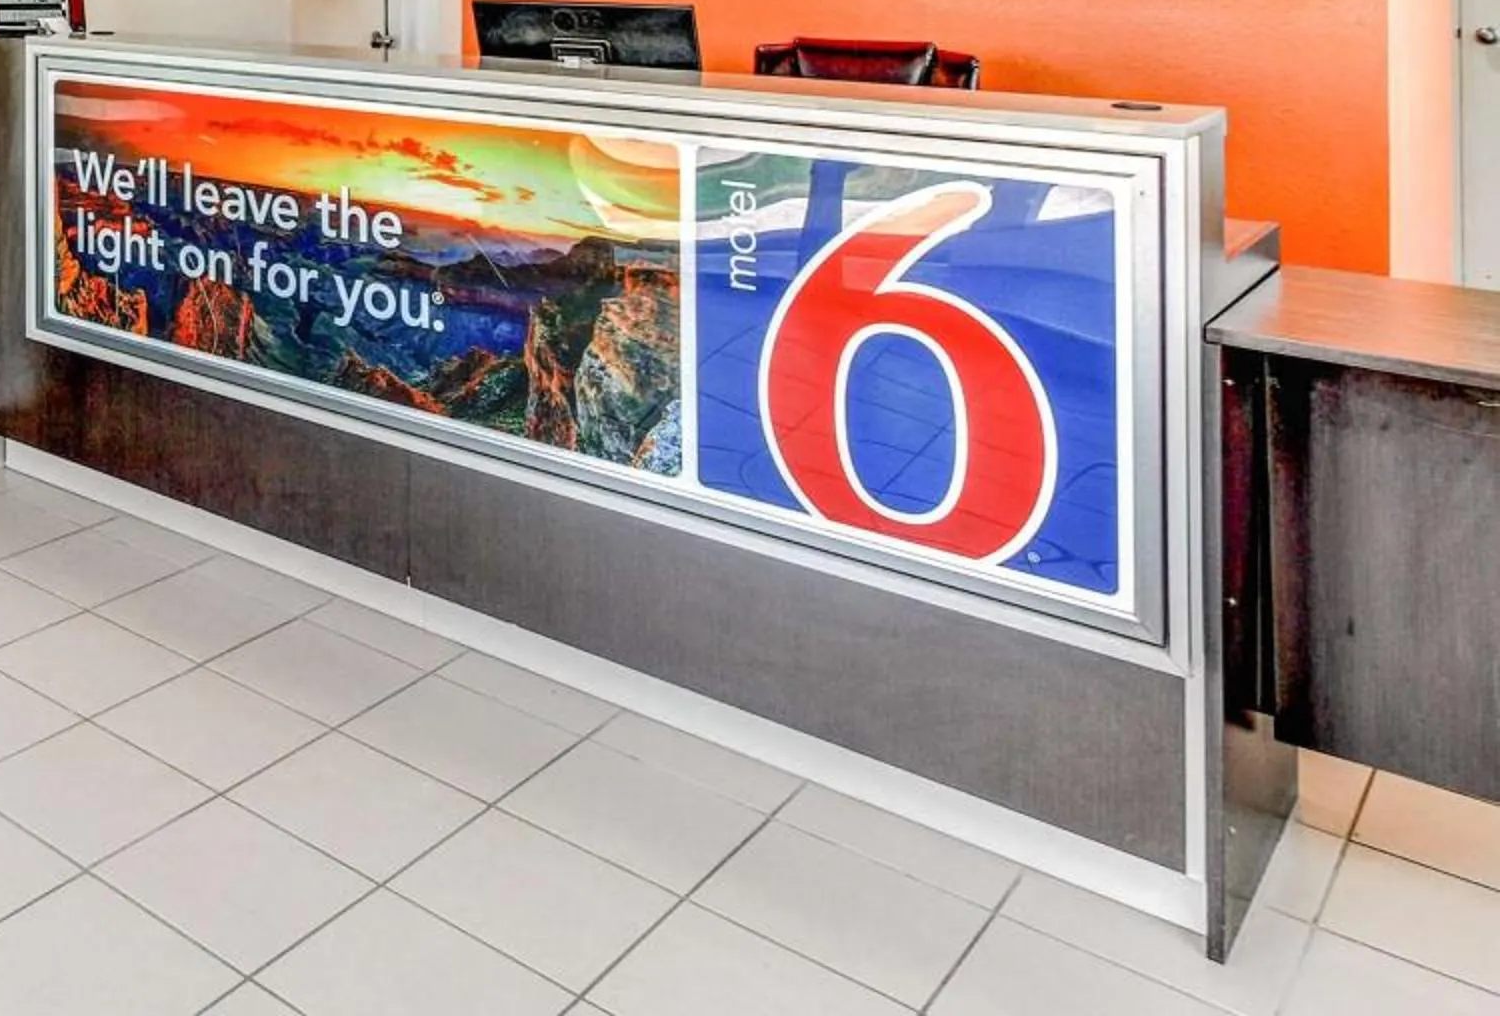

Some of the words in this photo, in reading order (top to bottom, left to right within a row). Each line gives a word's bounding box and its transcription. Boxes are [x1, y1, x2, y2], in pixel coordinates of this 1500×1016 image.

[73, 149, 167, 207] We'll
[183, 162, 300, 231] leave
[315, 186, 404, 250] the
[720, 179, 757, 291] motel
[76, 207, 165, 274] light
[178, 244, 233, 286] on
[248, 240, 318, 303] for
[757, 179, 1060, 568] 6
